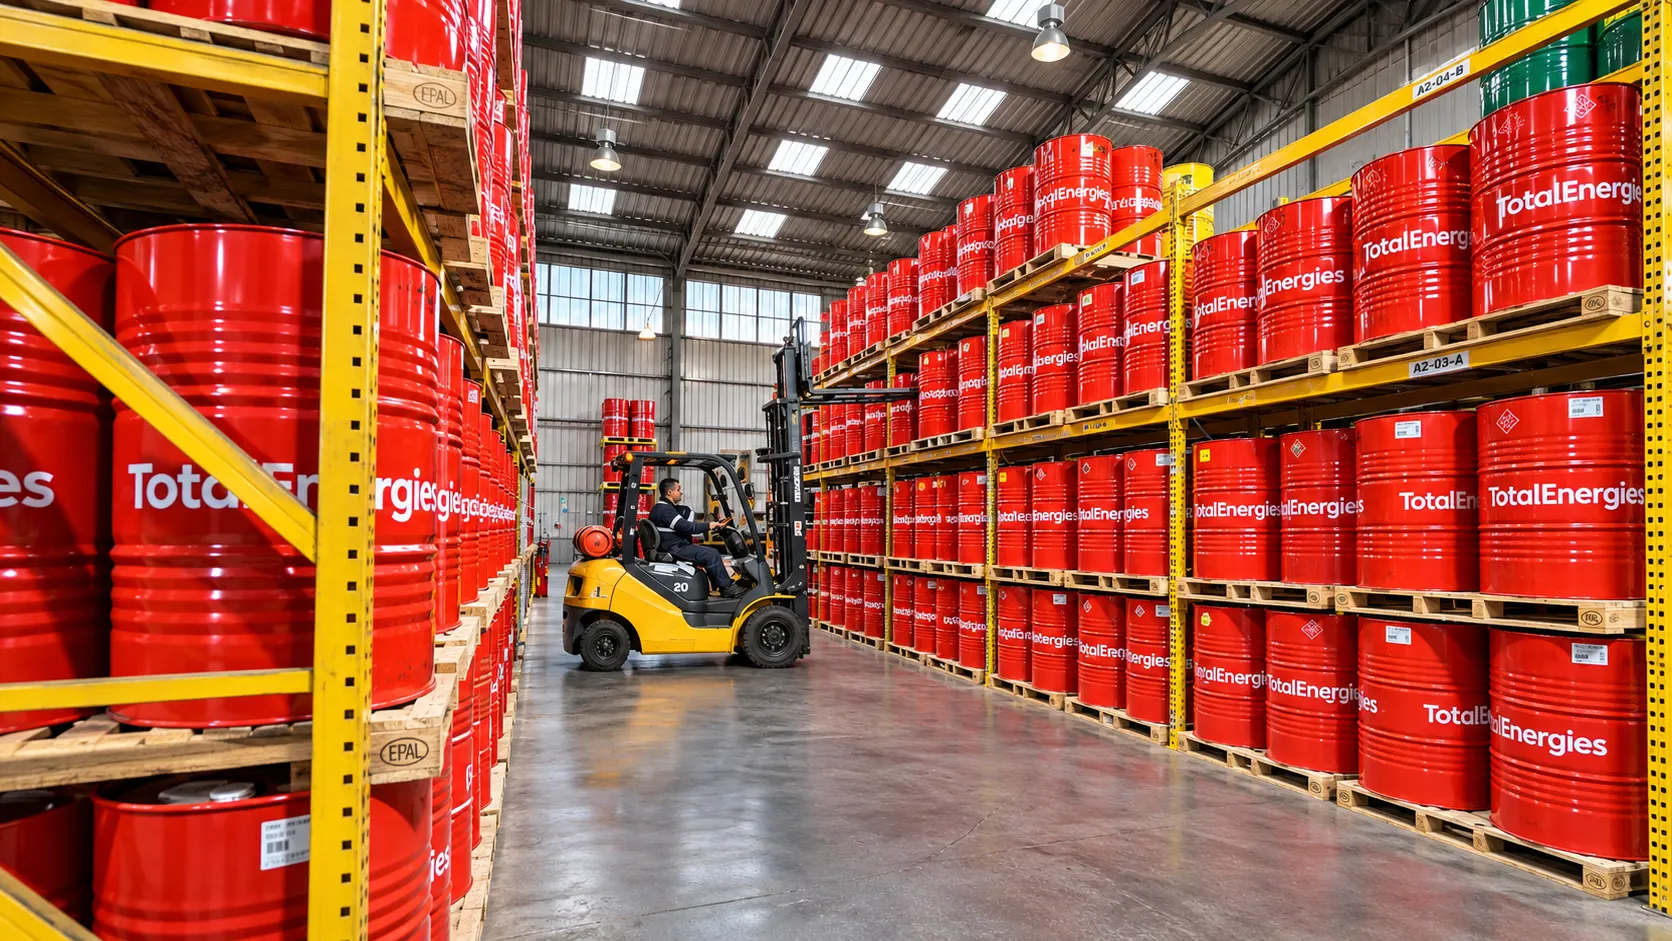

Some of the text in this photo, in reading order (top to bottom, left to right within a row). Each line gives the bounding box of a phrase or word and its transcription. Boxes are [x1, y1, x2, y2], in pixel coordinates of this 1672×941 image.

[1416, 64, 1464, 96] A2-04-B
[421, 86, 452, 105] EPAL
[1413, 353, 1464, 374] A2-03-A
[1488, 481, 1645, 511] TotalEnergies
[673, 582, 689, 593] 20
[389, 743, 423, 761] EPAL
